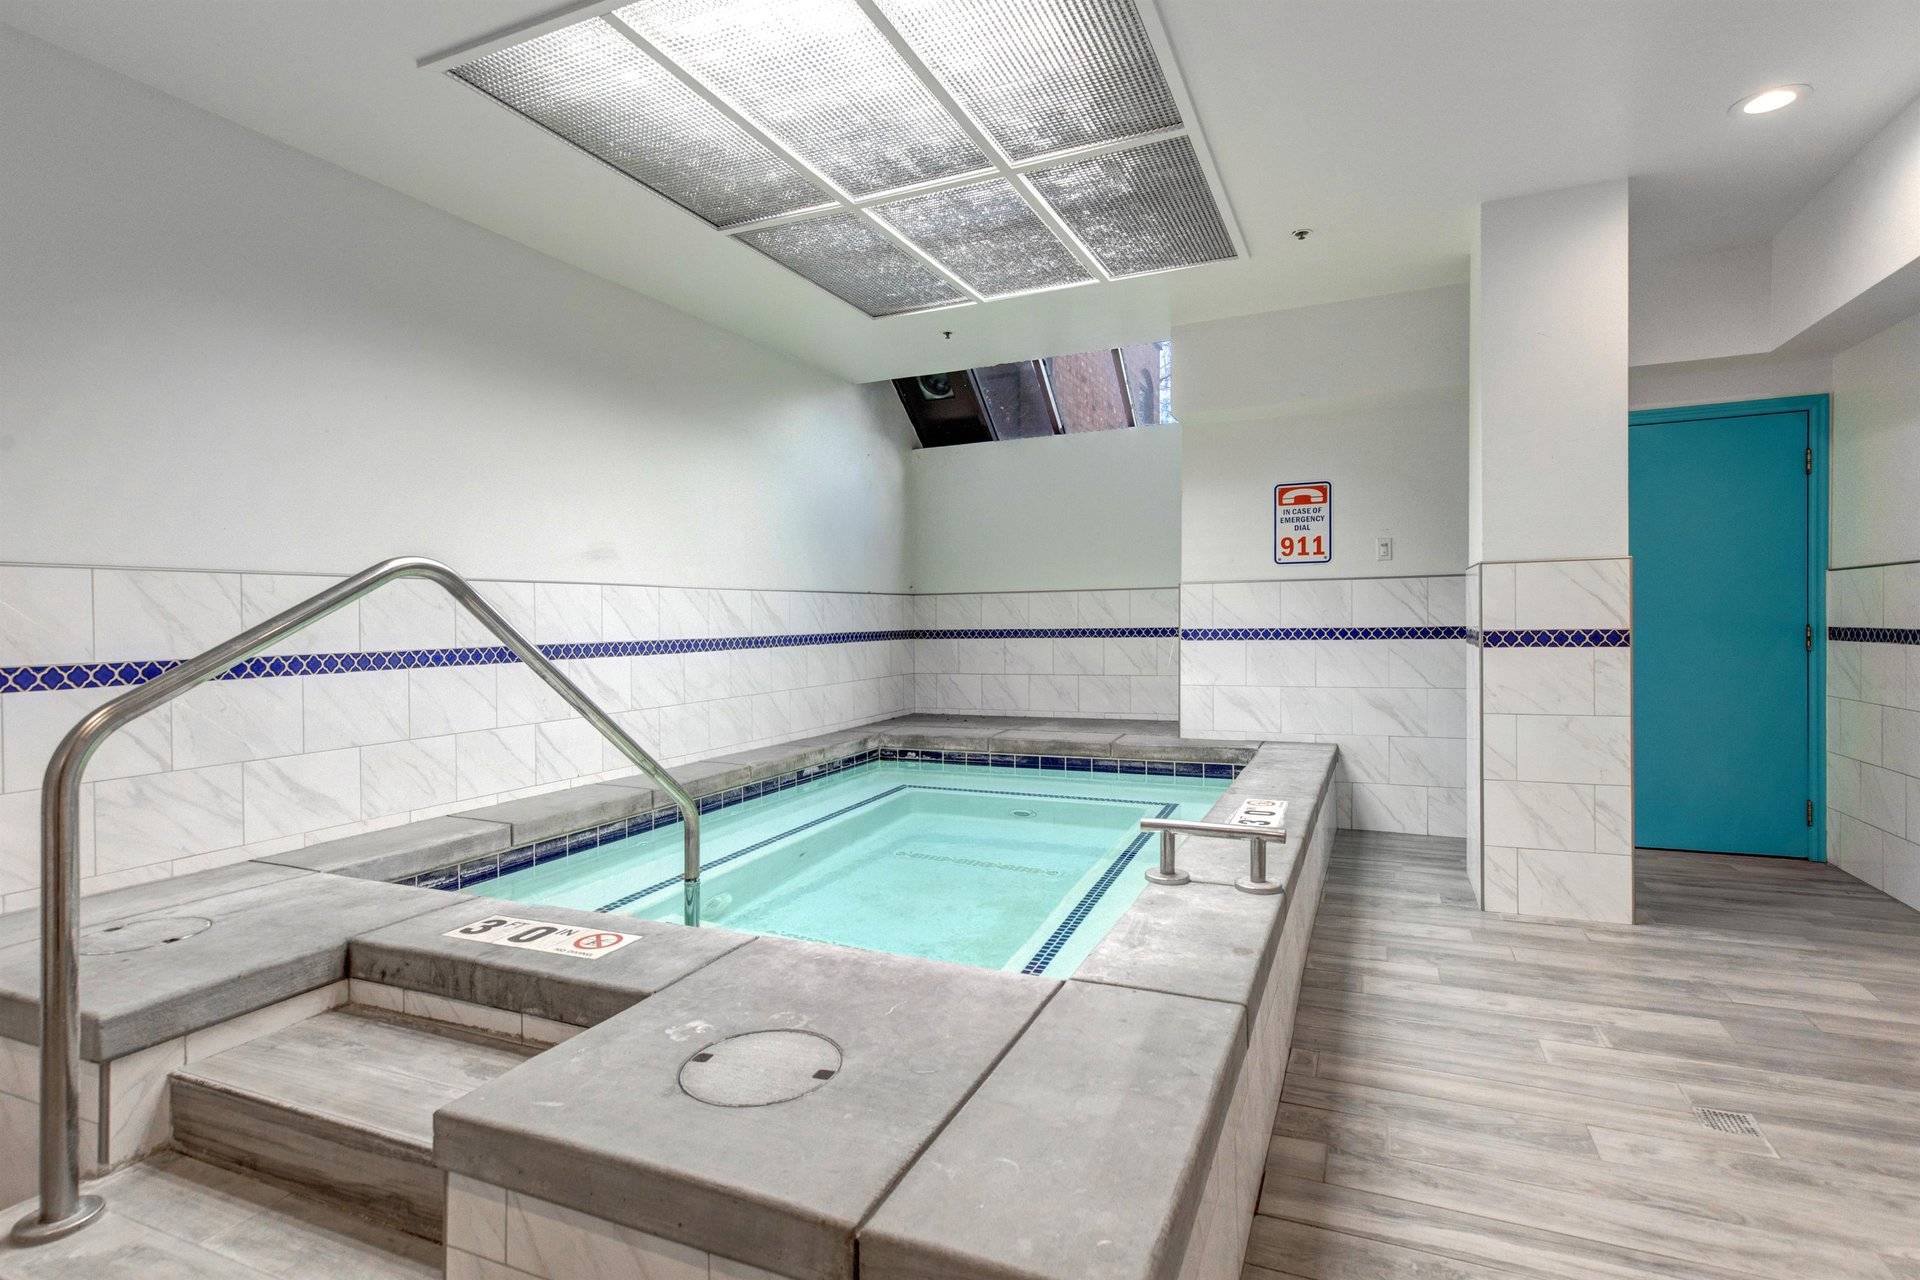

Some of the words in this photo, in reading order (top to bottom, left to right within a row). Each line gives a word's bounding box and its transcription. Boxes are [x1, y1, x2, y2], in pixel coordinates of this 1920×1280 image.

[1280, 515, 1325, 523] EMERGENCY
[1280, 535, 1325, 557] 911
[459, 919, 507, 935] 3
[507, 926, 559, 943] 0
[558, 928, 580, 937] IN
